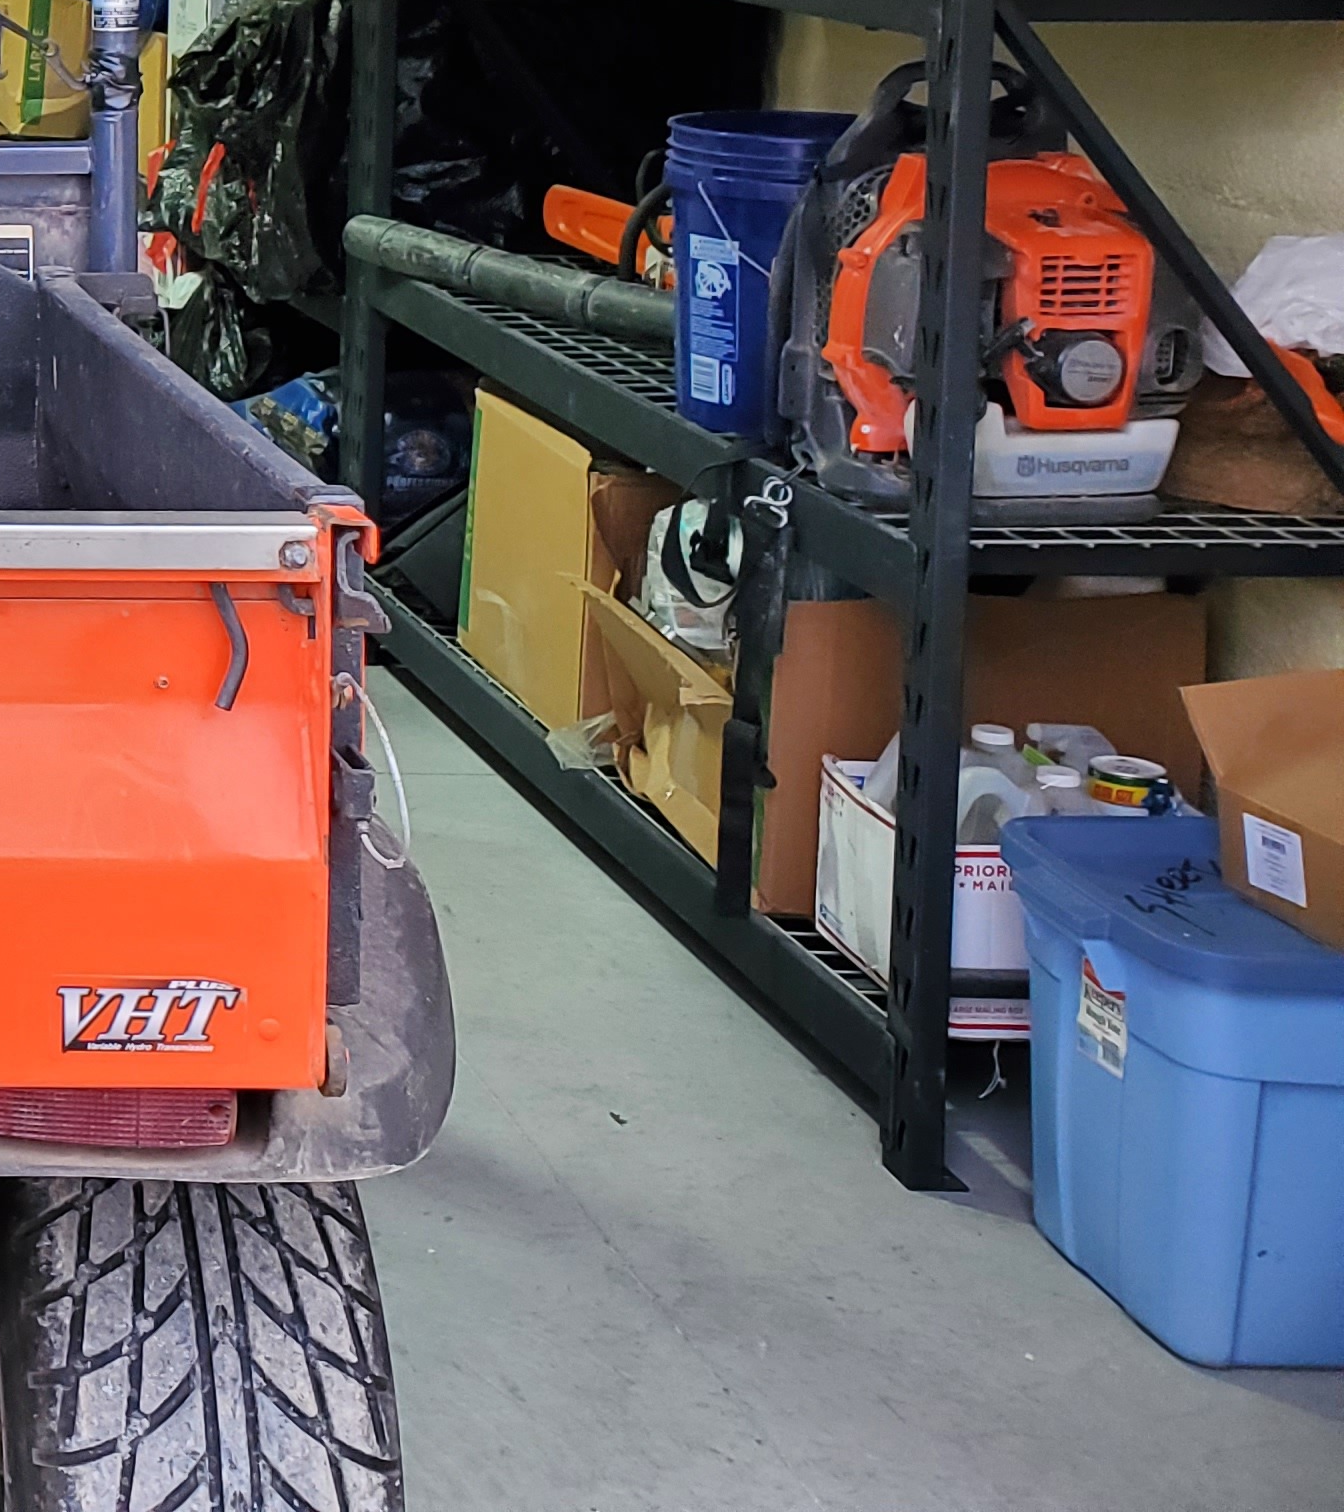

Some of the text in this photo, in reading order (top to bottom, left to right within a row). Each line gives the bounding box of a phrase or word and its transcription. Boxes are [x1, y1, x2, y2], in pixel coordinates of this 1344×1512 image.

[28, 28, 44, 82] LARE
[1037, 457, 1130, 475] Husqvarna
[954, 864, 1013, 878] PRIORI
[167, 980, 236, 991] PLUS
[57, 985, 241, 1049] VHT
[87, 1042, 214, 1053] Variable Hydro Transmission
